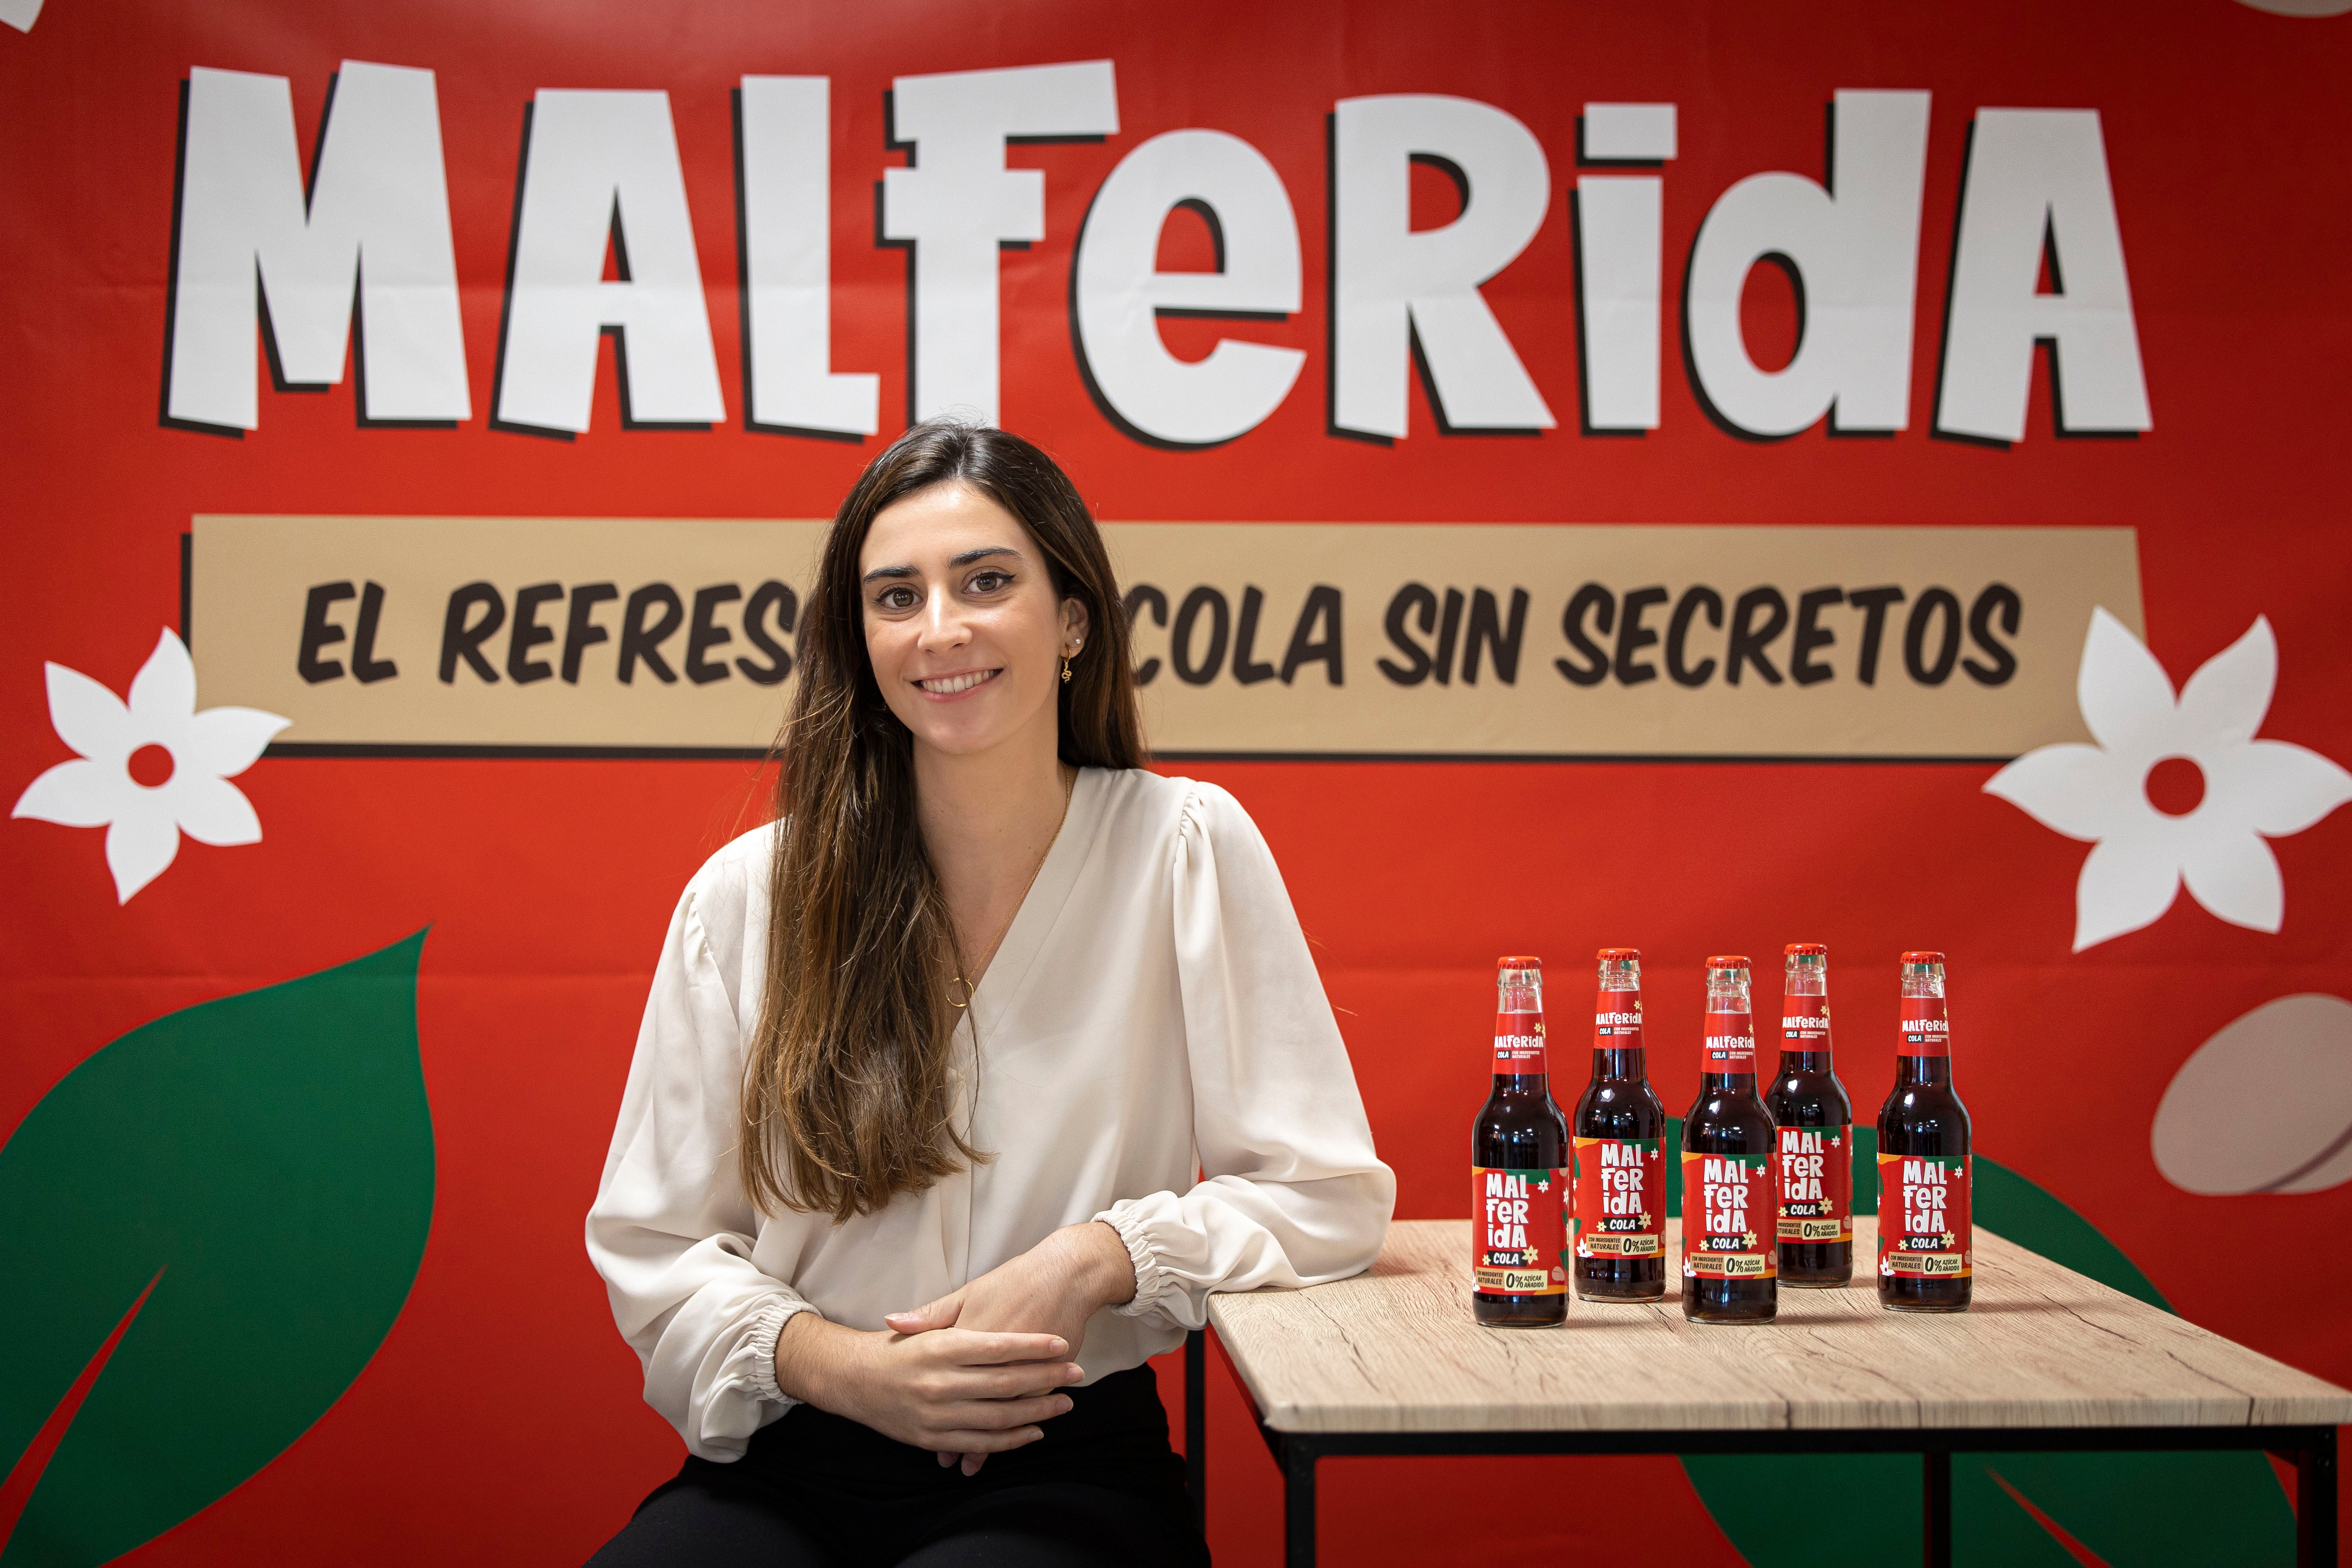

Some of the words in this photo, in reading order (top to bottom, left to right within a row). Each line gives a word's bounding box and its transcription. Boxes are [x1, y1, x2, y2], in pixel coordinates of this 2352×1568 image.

[296, 579, 398, 686] EL
[438, 579, 799, 687] REFRES
[1118, 582, 1344, 688] COLA
[1375, 582, 1531, 688] SIN
[1554, 582, 2022, 689] SECRETOS
[1782, 1131, 1824, 1154] MAL
[1601, 1143, 1644, 1167] MAL
[1703, 1159, 1748, 1184] MAL
[1903, 1161, 1947, 1185] MAL
[1486, 1173, 1529, 1199] MAL
[1791, 1205, 1816, 1215] COLA
[1610, 1219, 1635, 1230] COLA
[1804, 1223, 1820, 1237] 0%
[1623, 1238, 1639, 1253] 0%
[1712, 1238, 1739, 1249] COLA
[1912, 1238, 1938, 1249] COLA
[1493, 1253, 1519, 1265] COLA
[1726, 1258, 1743, 1273] 0%
[1925, 1257, 1942, 1272] 0%
[1506, 1273, 1523, 1288] 0%
